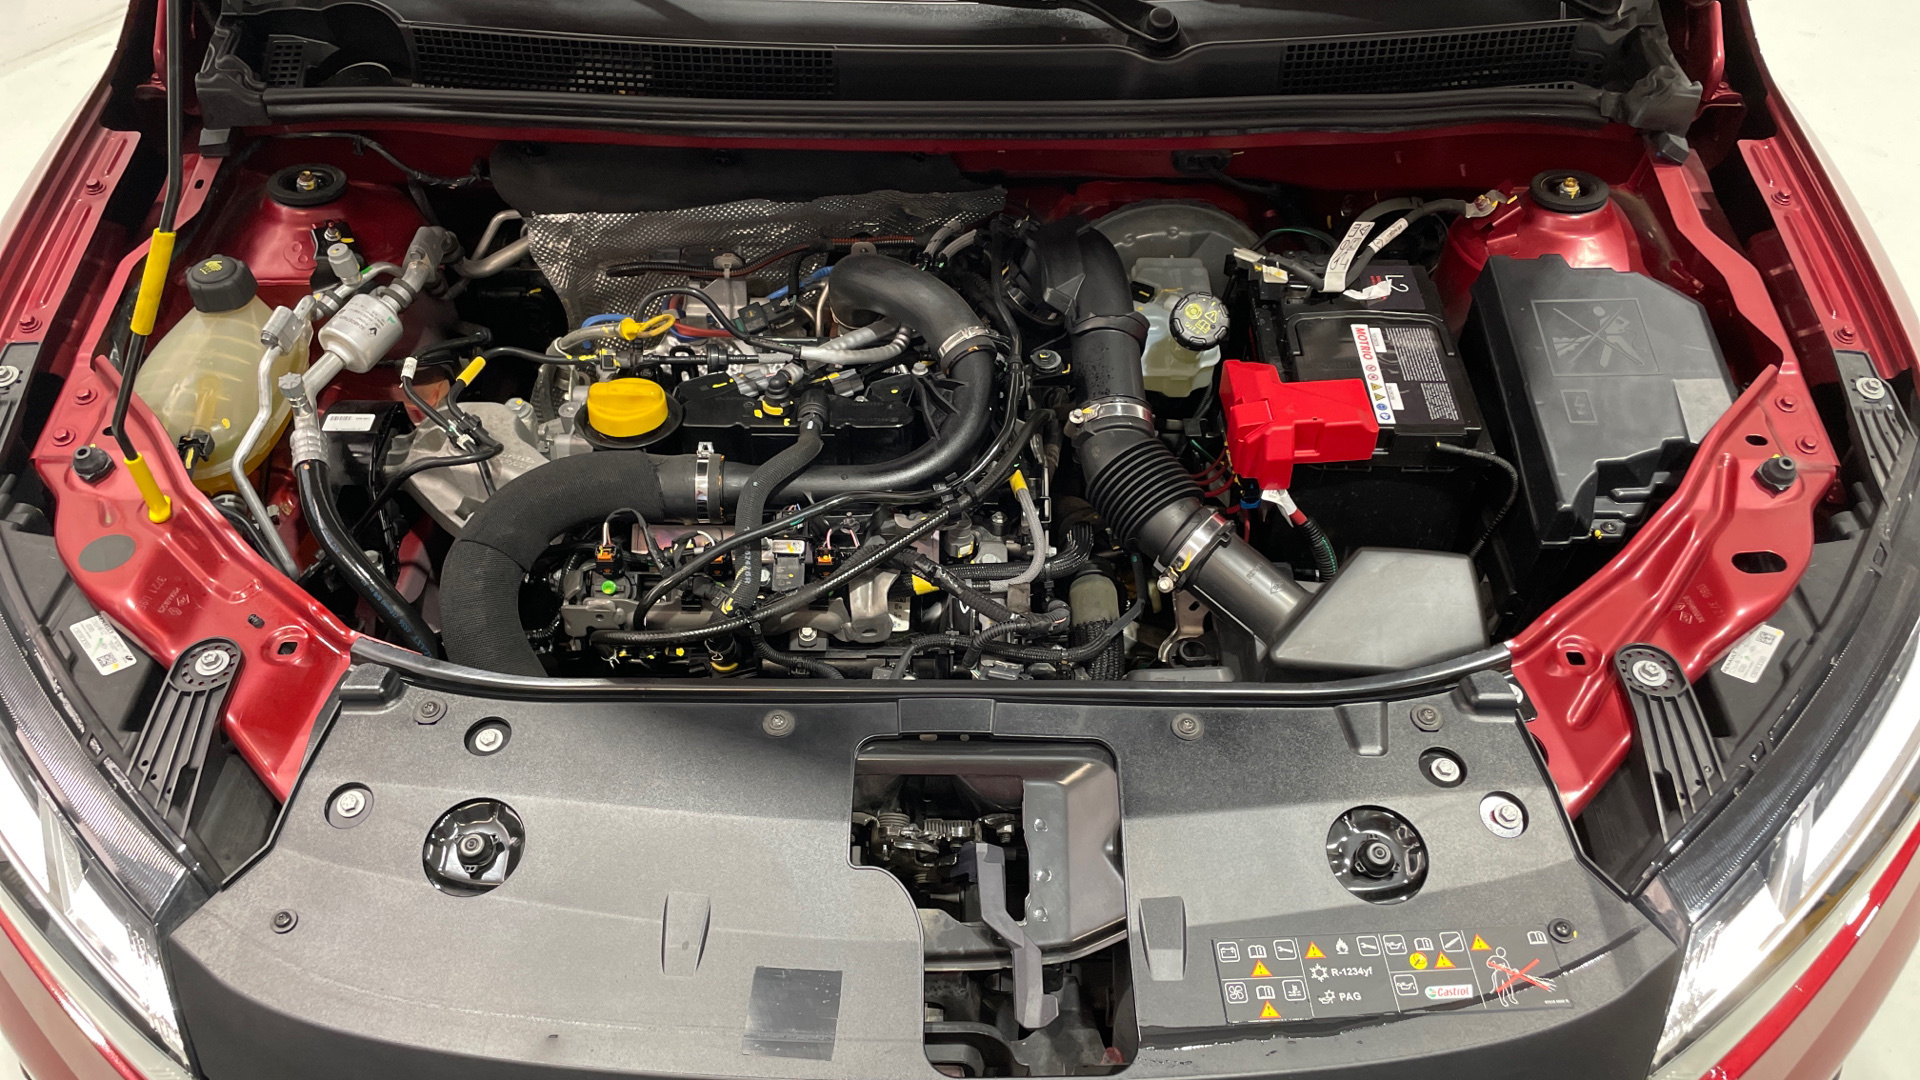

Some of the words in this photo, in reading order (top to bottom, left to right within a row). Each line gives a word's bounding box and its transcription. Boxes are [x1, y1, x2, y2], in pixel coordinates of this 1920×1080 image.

[1355, 326, 1373, 360] MOTRIO
[1330, 965, 1372, 977] R-1234yf
[1338, 991, 1362, 1001] PAG
[1437, 986, 1469, 998] Castrol
